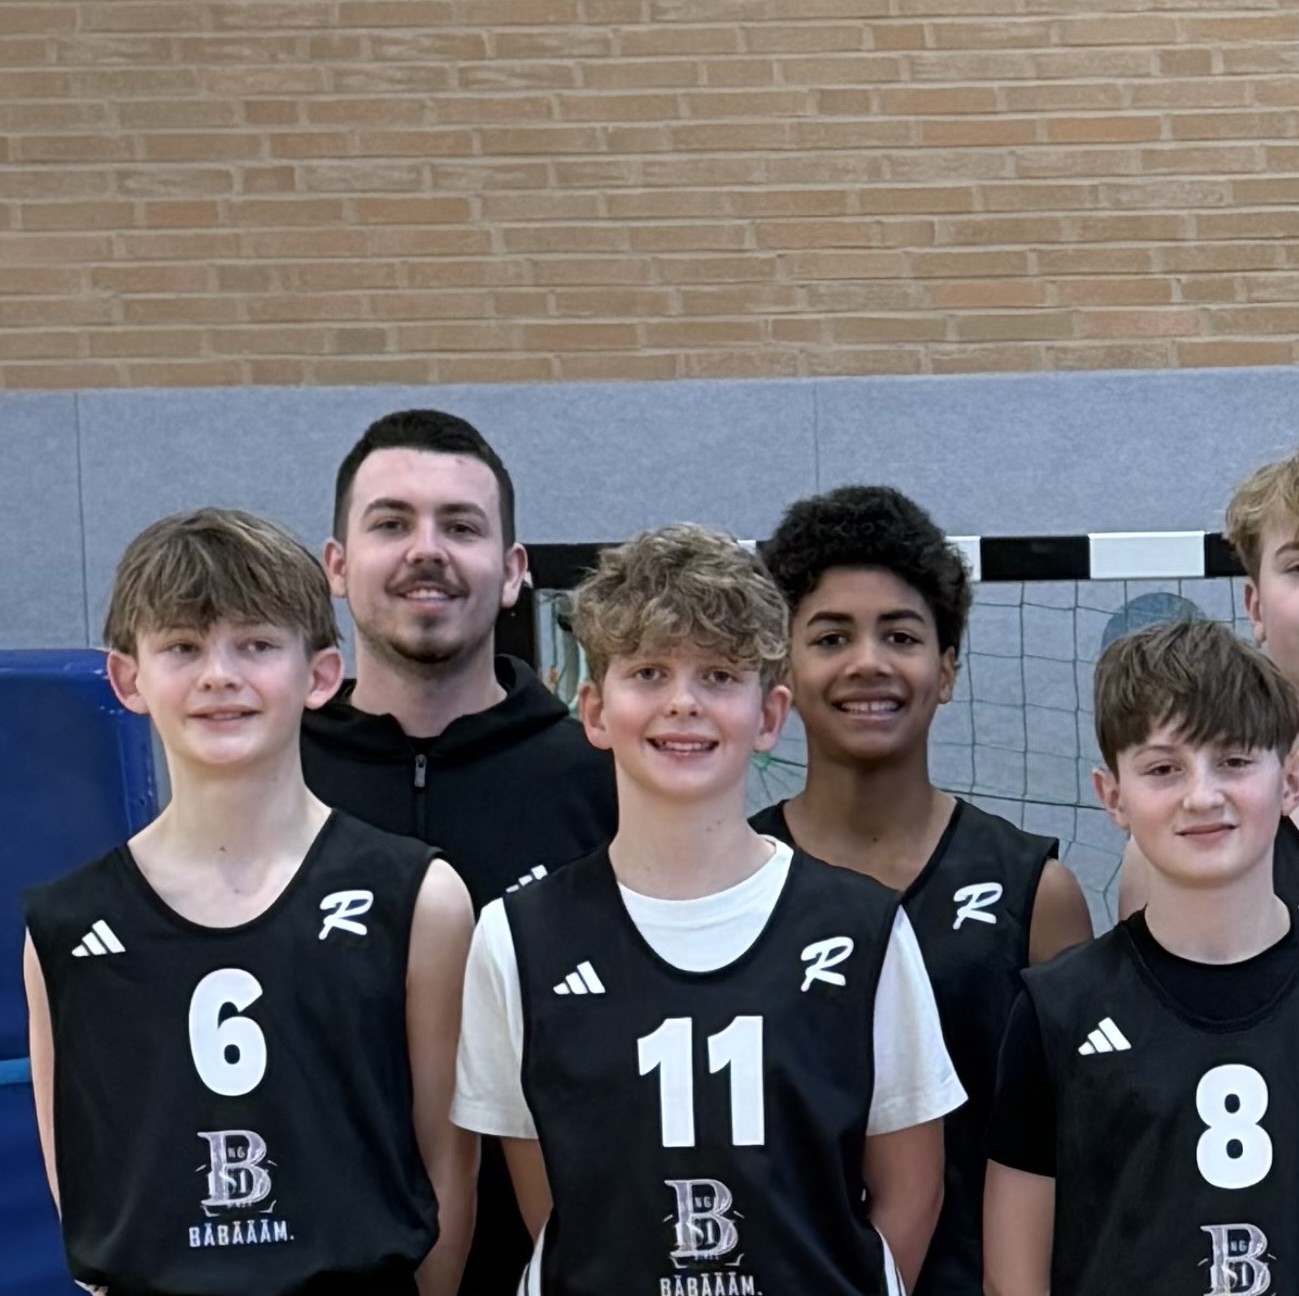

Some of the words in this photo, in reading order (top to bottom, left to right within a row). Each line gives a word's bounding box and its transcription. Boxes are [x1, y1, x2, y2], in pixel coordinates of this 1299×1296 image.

[319, 890, 373, 939] R
[953, 883, 1002, 929] R
[801, 937, 853, 991] R
[189, 969, 266, 1096] 6
[638, 1016, 764, 1147] 11
[1196, 1064, 1272, 1189] 8
